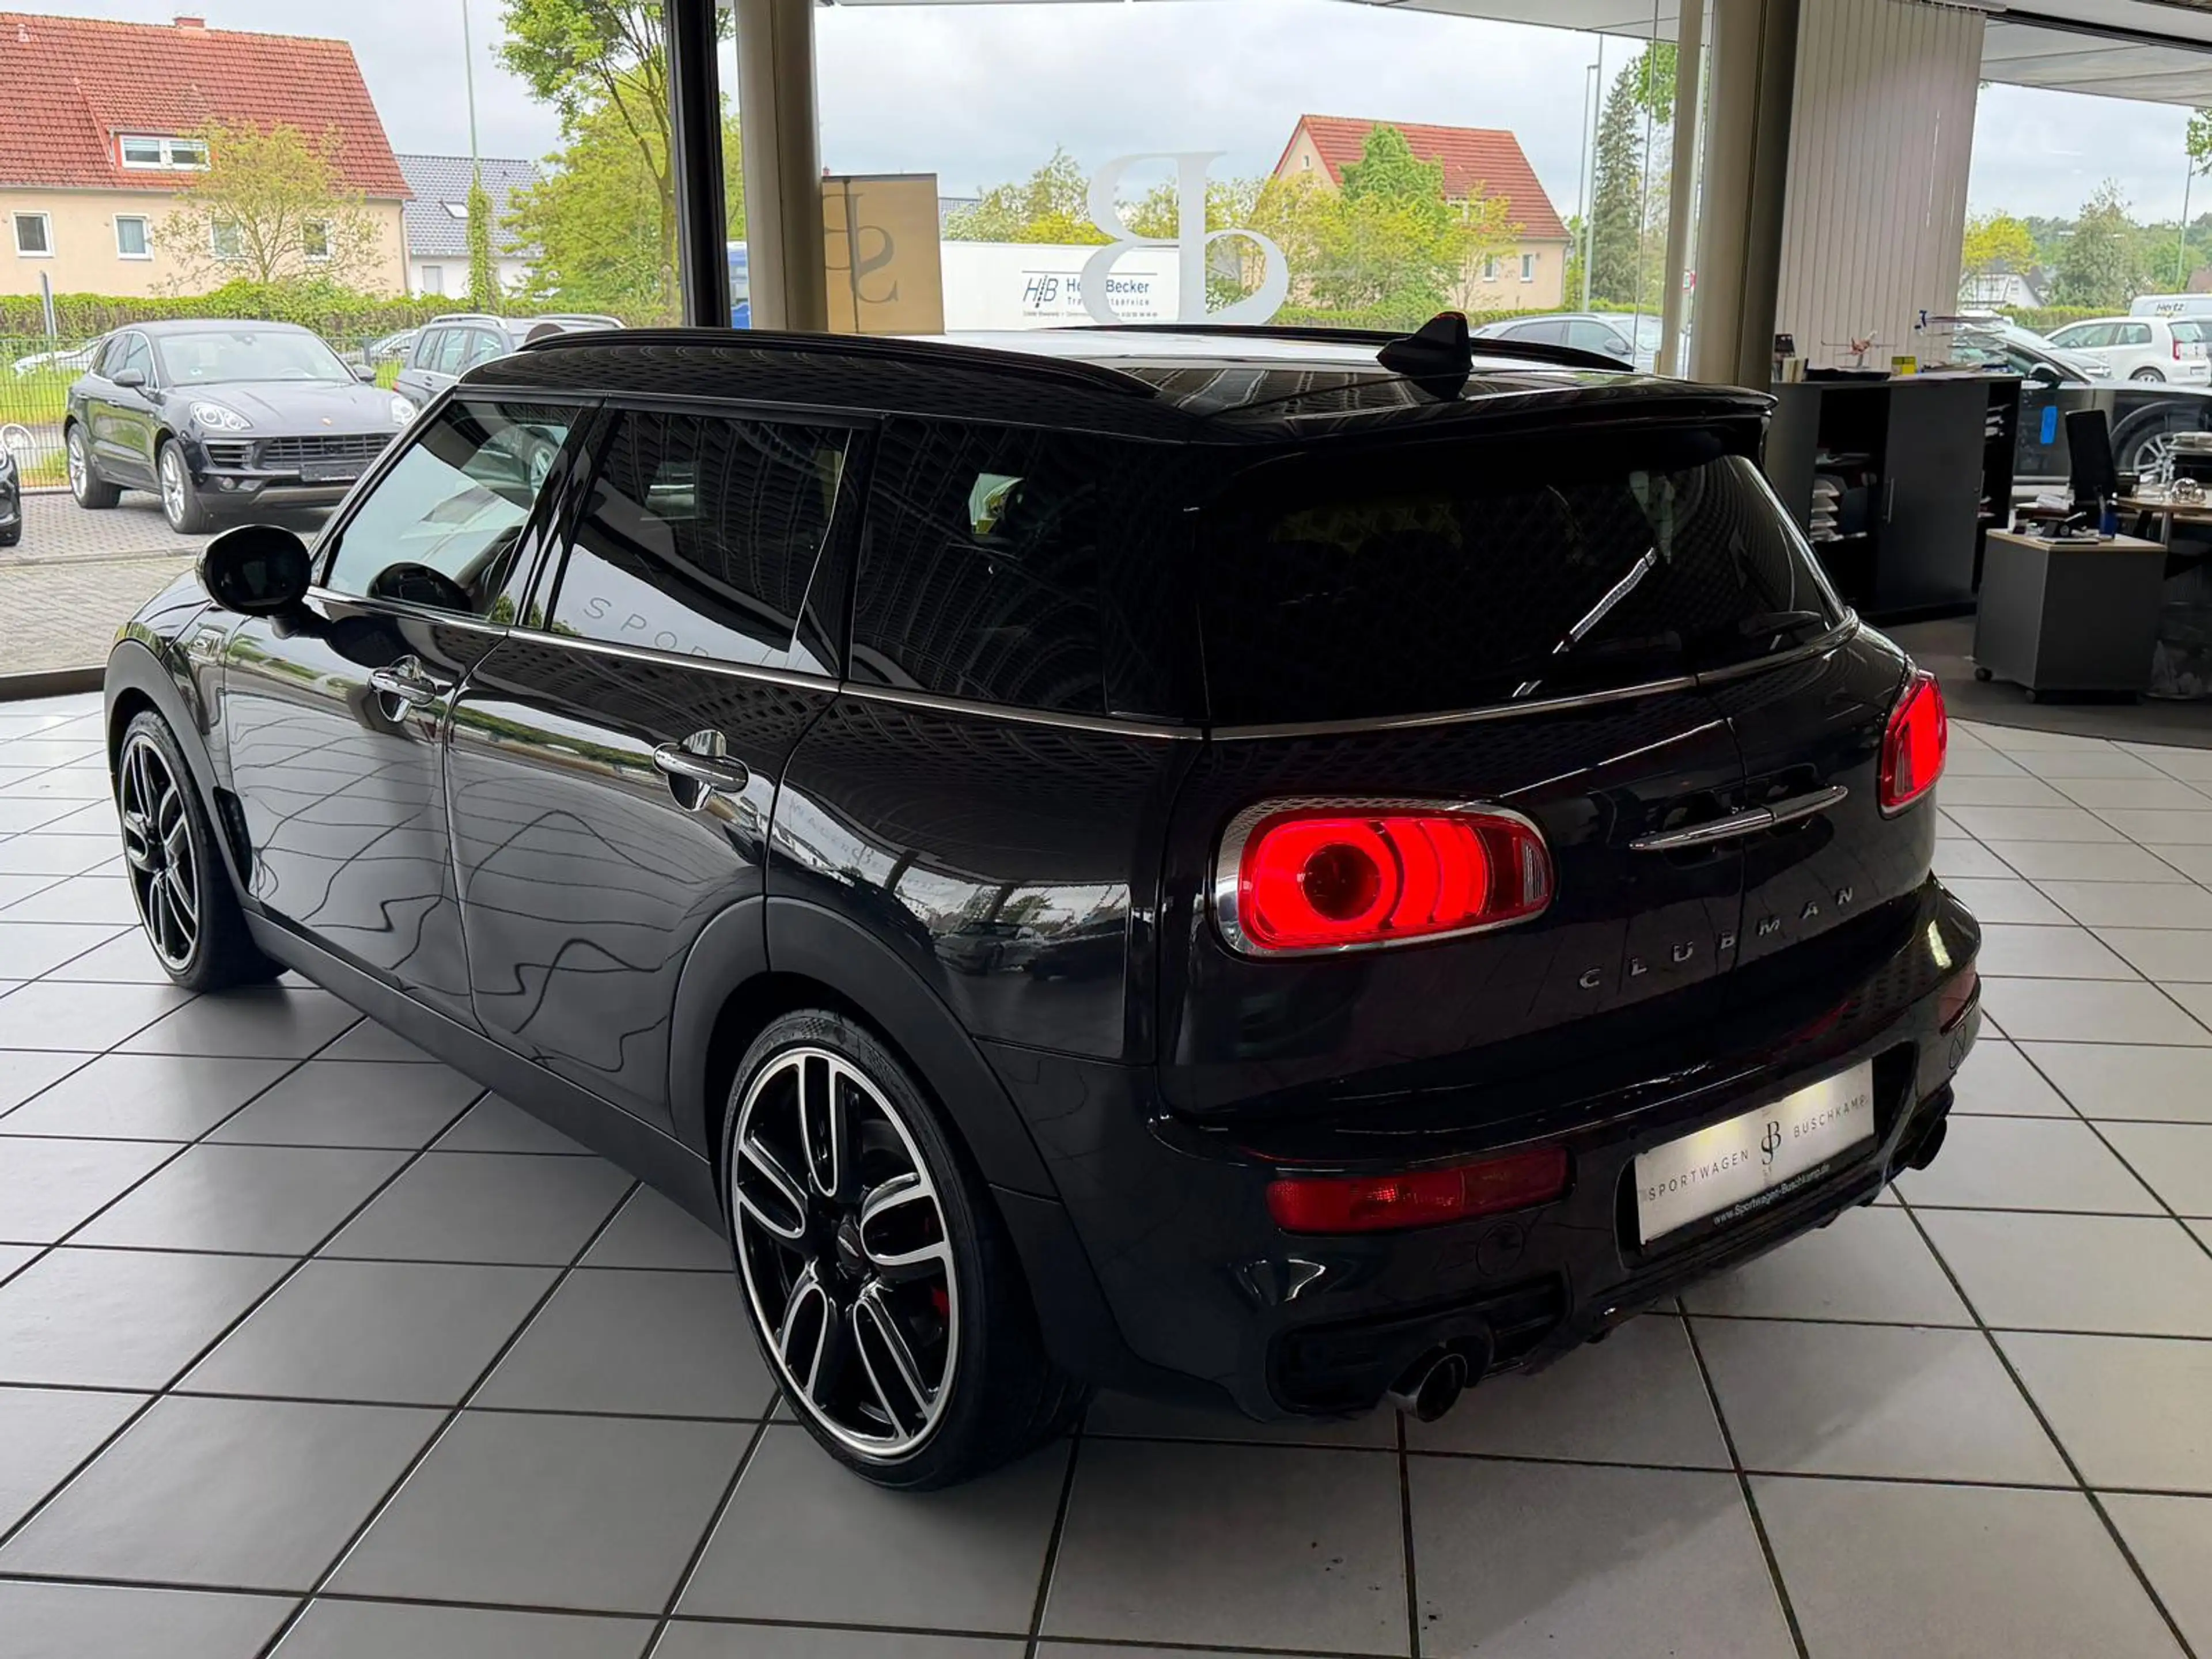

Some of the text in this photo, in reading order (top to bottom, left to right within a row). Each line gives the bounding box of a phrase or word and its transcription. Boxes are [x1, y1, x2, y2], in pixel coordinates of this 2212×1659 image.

[1105, 279, 1150, 293] Becker
[1579, 887, 1854, 989] CLUBMAN
[1648, 1150, 1749, 1201] SPORTWAGEN
[1793, 1094, 1868, 1138] BUSCHKAMP
